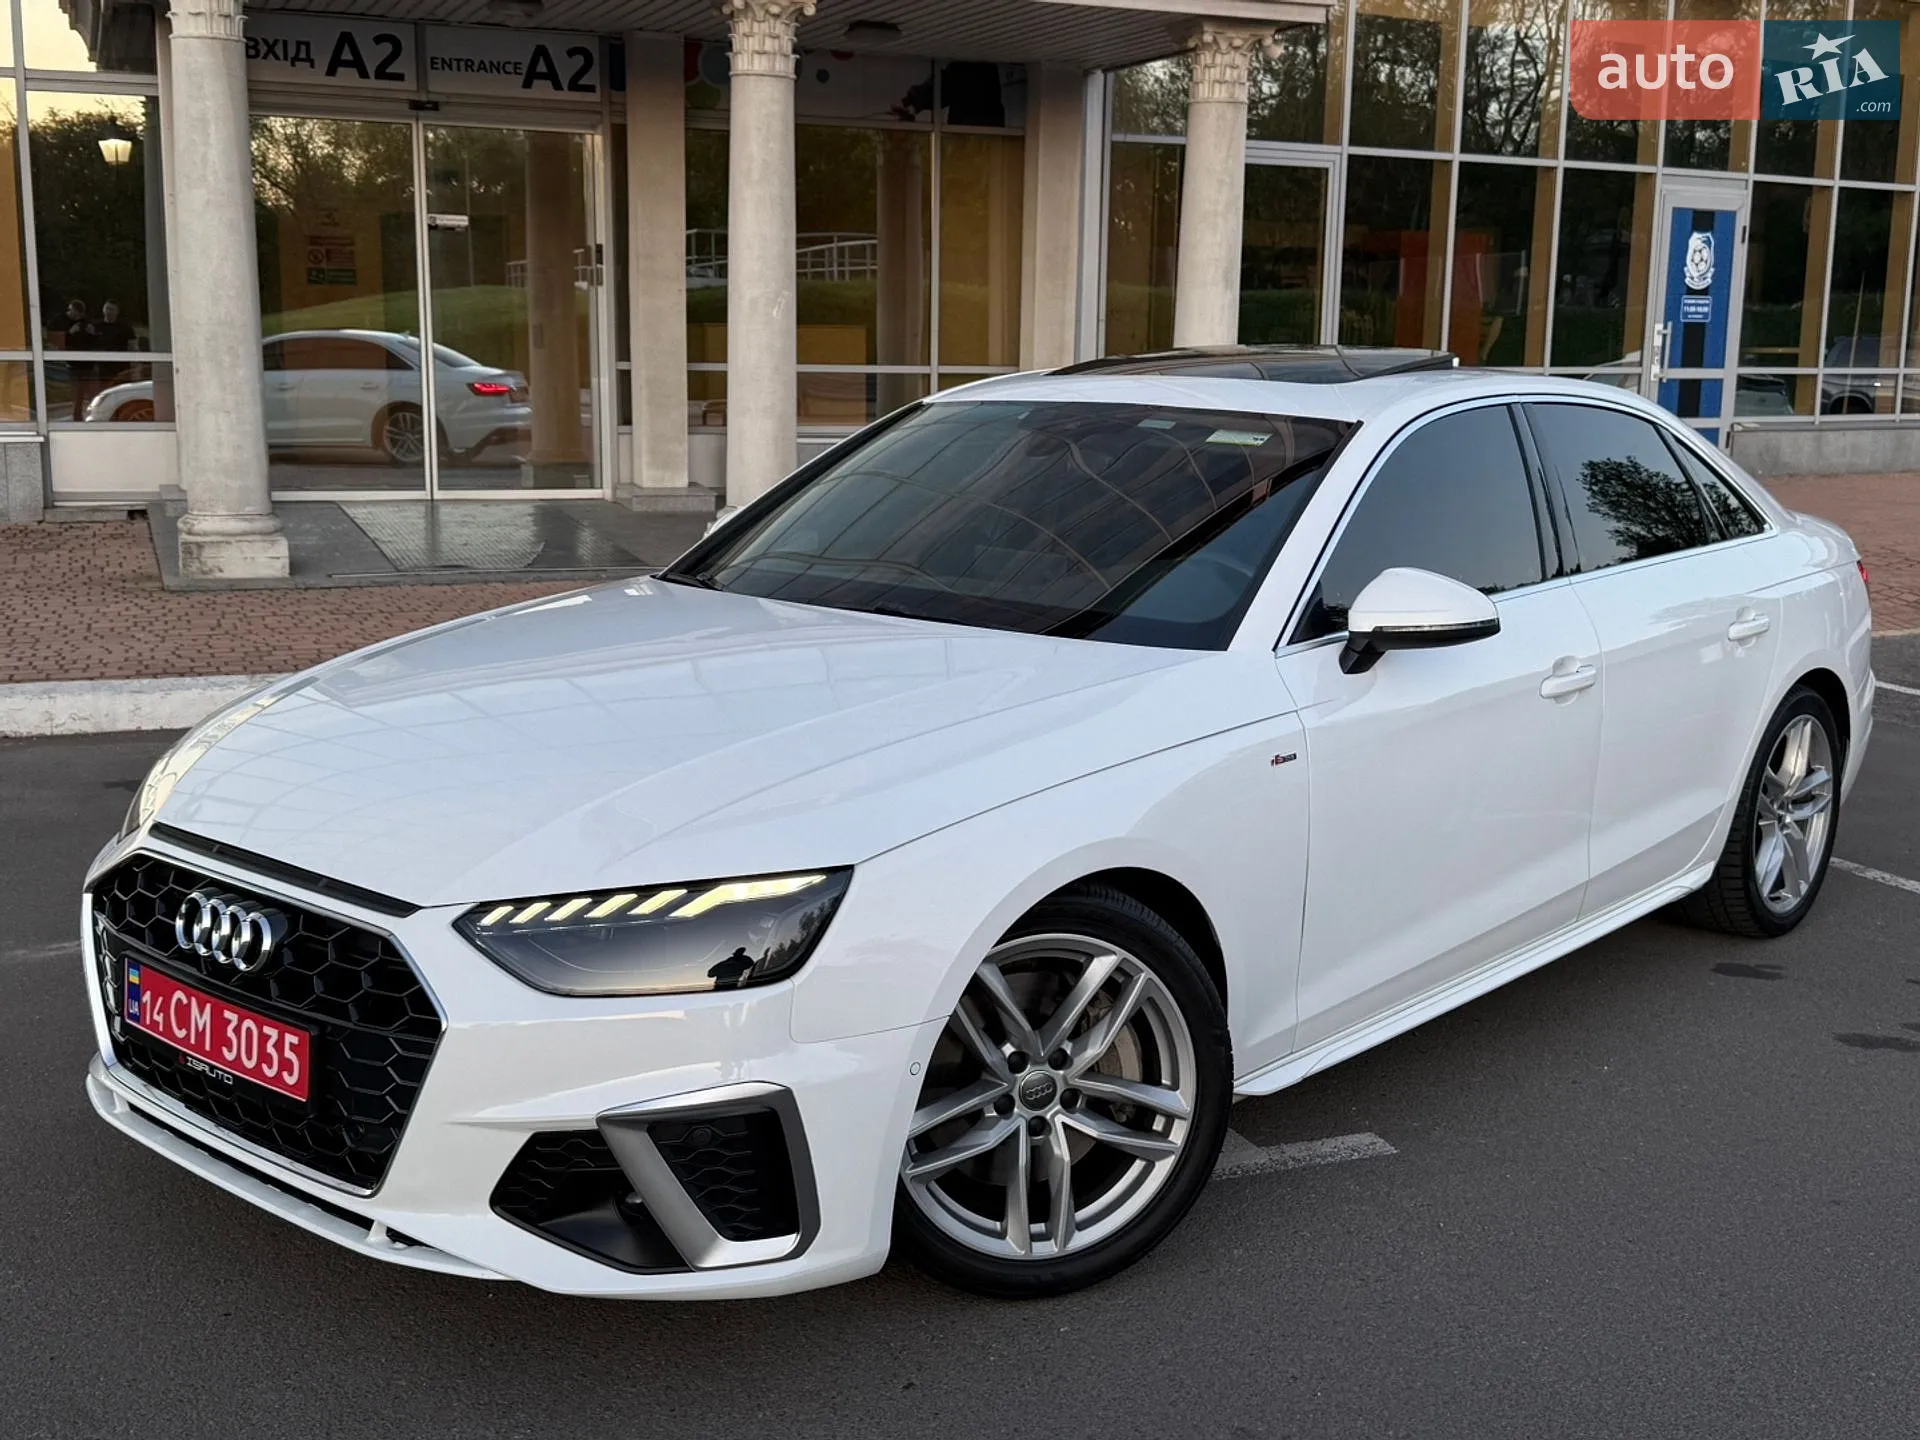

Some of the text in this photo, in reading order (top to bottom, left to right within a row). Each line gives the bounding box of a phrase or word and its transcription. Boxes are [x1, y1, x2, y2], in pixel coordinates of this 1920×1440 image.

[245, 36, 315, 69] ВХІД
[429, 44, 597, 94] ENTRANCE A2
[128, 998, 140, 1017] UA
[221, 1009, 300, 1086] 3035
